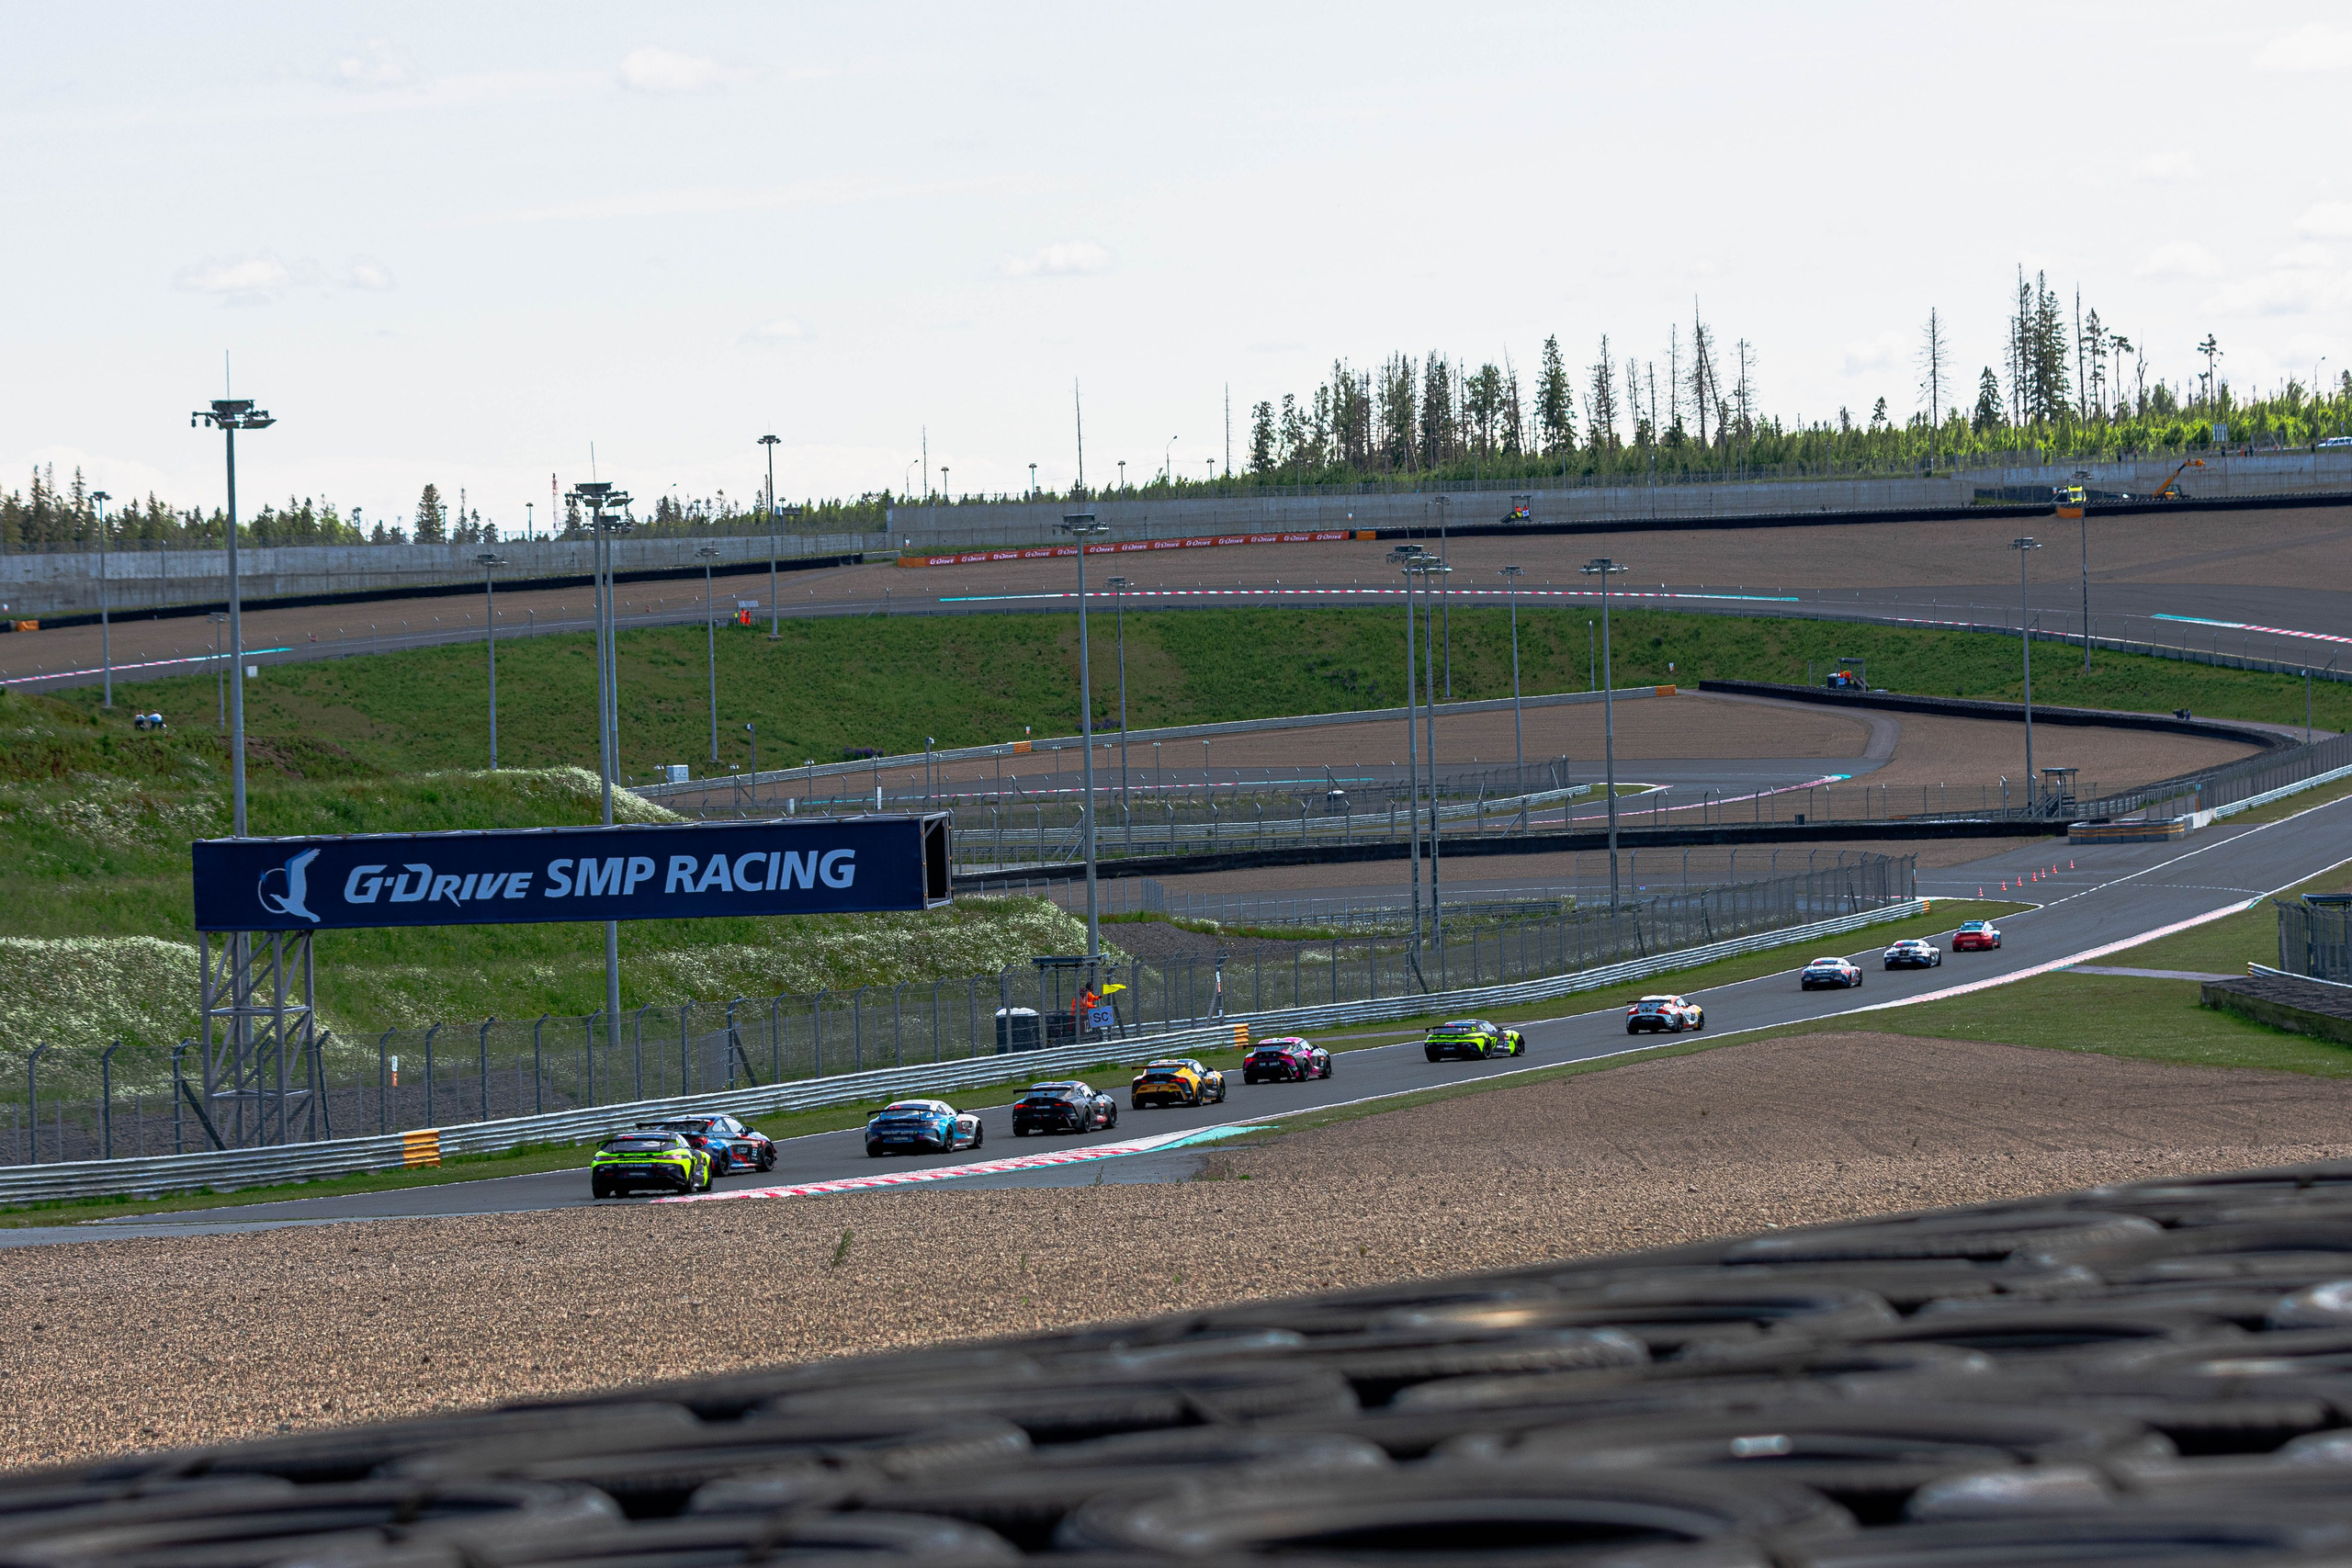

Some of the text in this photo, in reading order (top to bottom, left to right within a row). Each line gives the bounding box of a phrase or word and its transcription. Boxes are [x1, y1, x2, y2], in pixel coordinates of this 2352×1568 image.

[544, 856, 655, 897] SMP
[664, 849, 855, 893] RACING
[1092, 1011, 1109, 1023] SC
